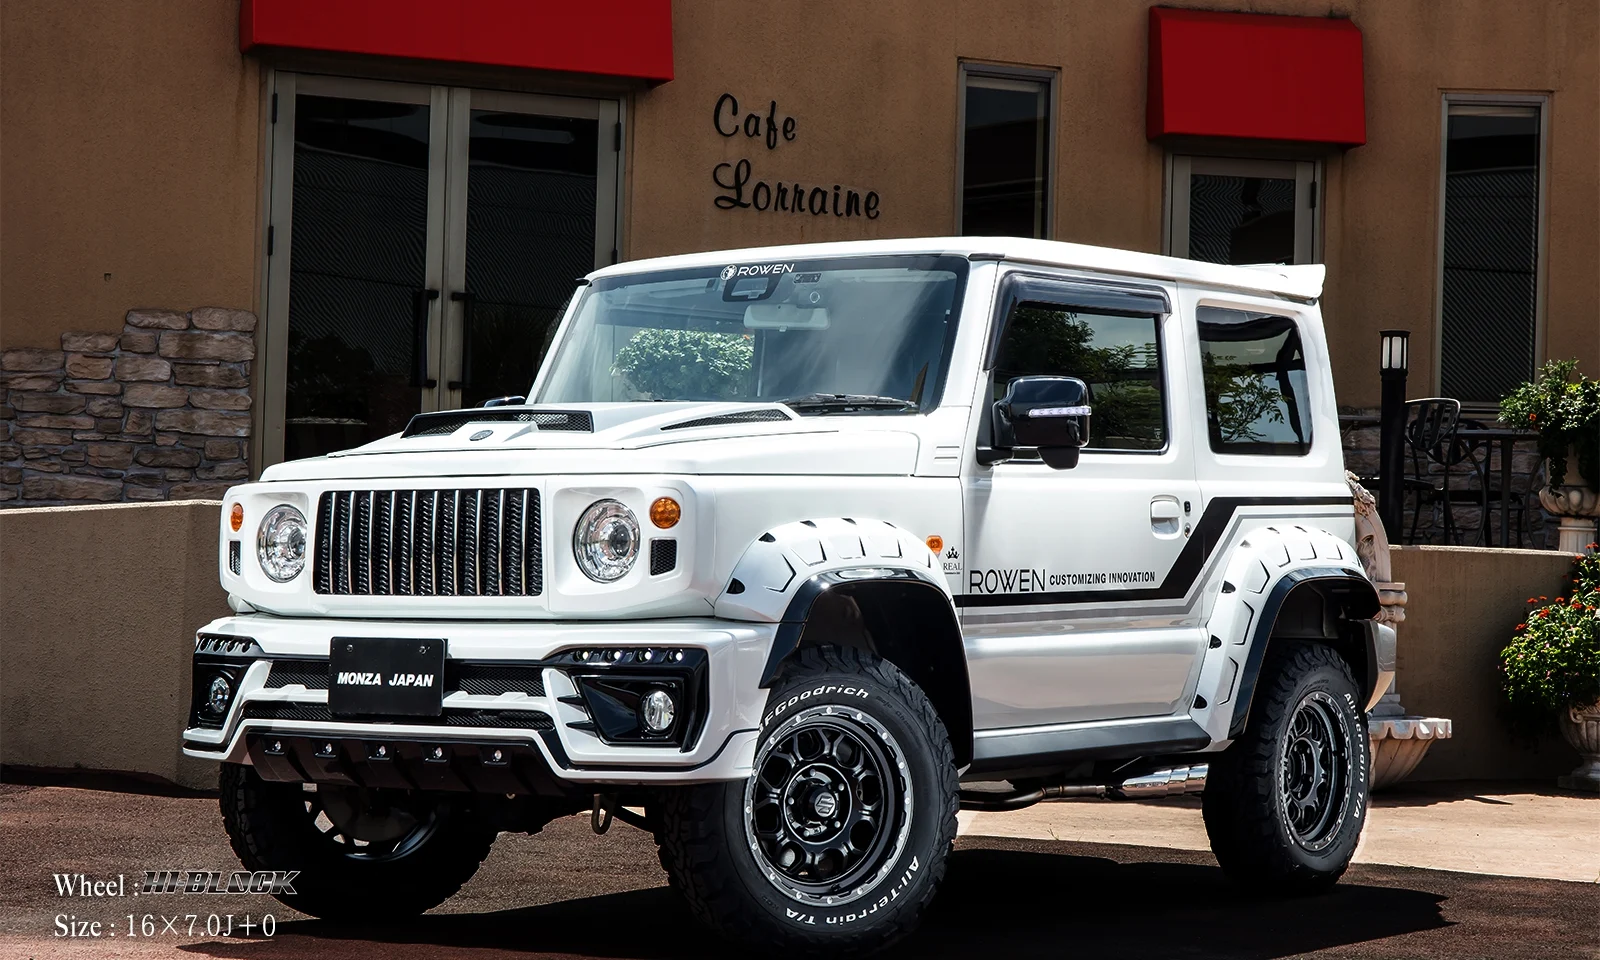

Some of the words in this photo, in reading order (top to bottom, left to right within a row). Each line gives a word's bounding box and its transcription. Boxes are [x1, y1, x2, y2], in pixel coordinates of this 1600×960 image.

[713, 93, 796, 150] Cafe
[712, 158, 880, 220] Lorraine
[737, 263, 795, 276] ROWEN
[943, 562, 963, 571] REAL
[969, 568, 1045, 594] ROWEN
[1049, 573, 1106, 586] CUSTOMIZING
[1108, 571, 1155, 584] INNOVATION
[337, 672, 381, 686] MONZA
[388, 673, 434, 687] JAPAN
[1344, 693, 1365, 783] All-Terrain
[826, 855, 920, 926] All-Terrain
[785, 907, 816, 925] T/A
